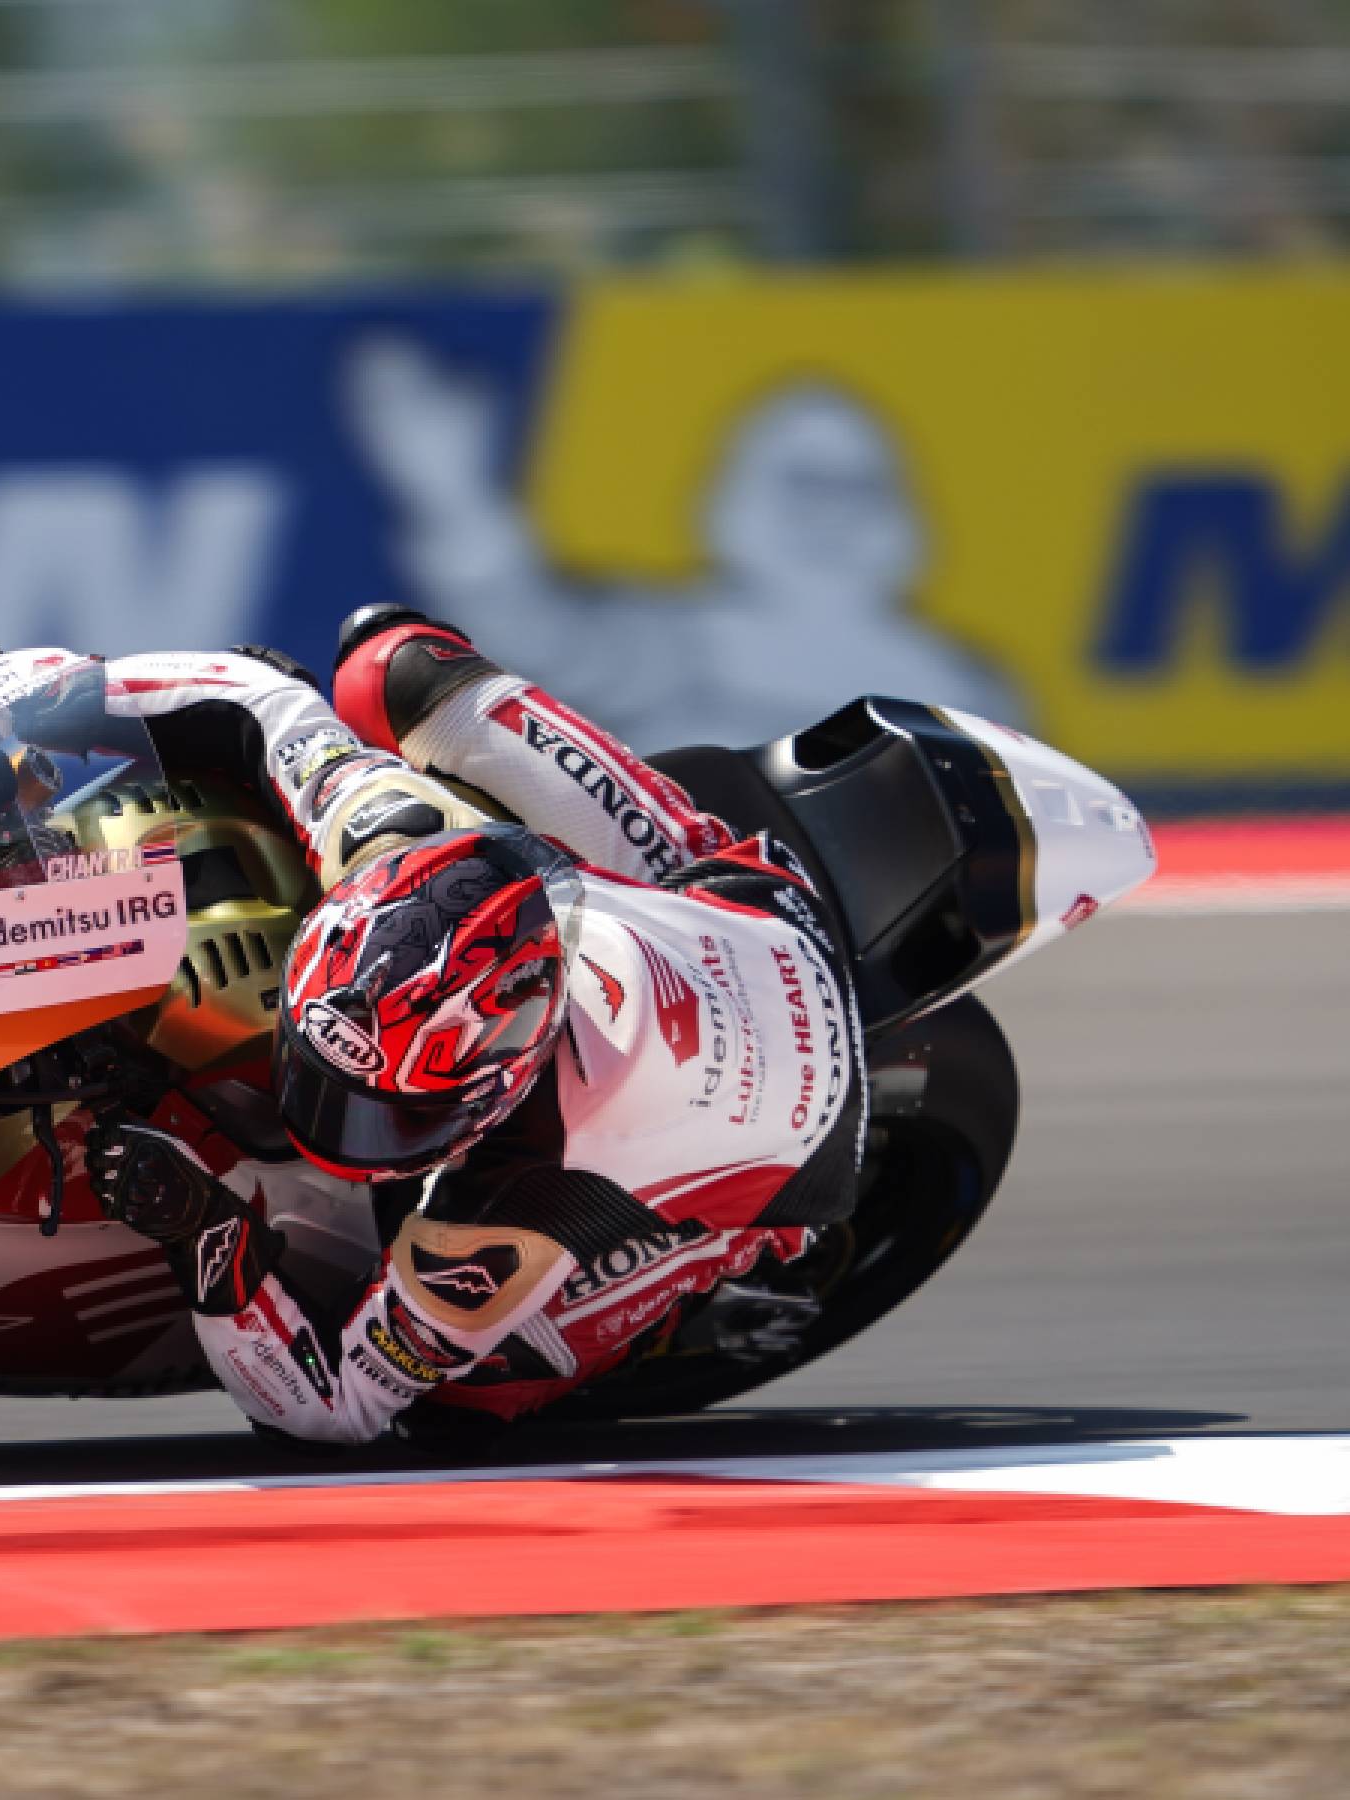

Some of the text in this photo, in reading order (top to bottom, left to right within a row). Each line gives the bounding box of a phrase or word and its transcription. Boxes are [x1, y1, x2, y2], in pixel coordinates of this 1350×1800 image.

[526, 714, 678, 884] HONDA
[117, 891, 178, 927] IRG
[771, 945, 814, 1054] HEART
[791, 1064, 816, 1129] One
